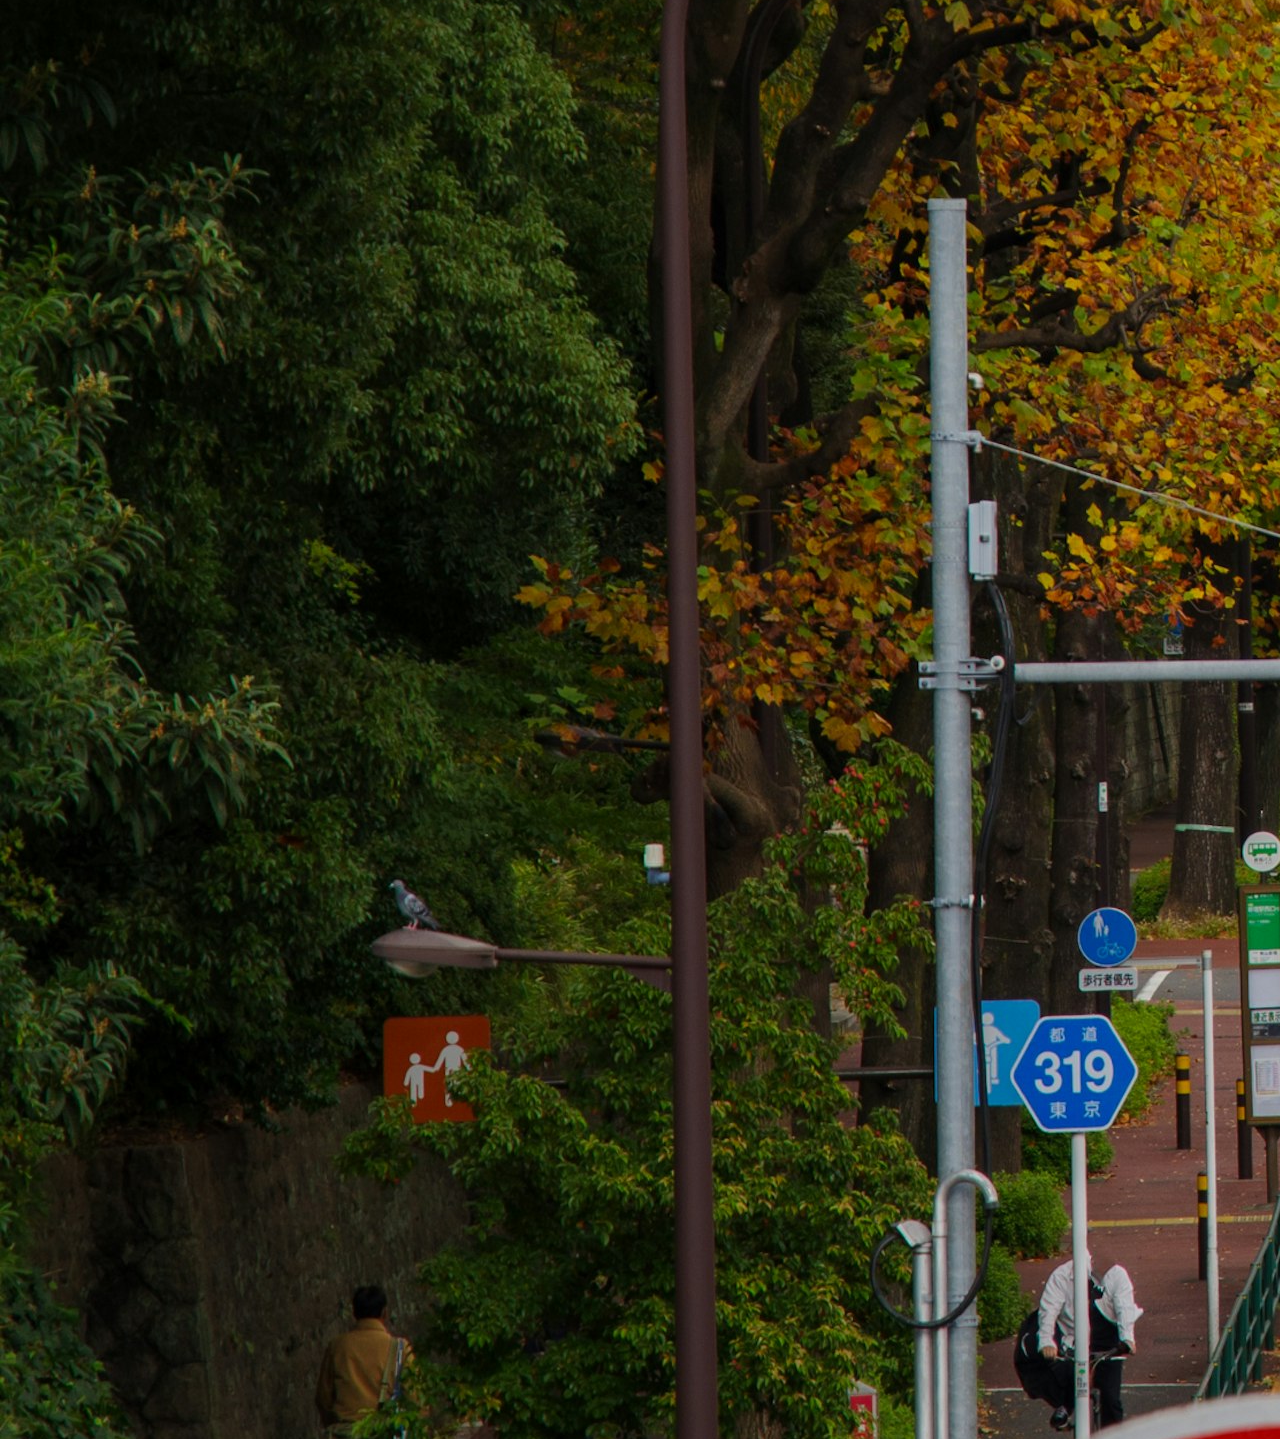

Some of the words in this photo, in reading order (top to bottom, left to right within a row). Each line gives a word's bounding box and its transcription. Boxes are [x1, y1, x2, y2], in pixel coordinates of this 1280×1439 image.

[1083, 974, 1134, 987] 歩行者優先
[1034, 1049, 1115, 1094] 319
